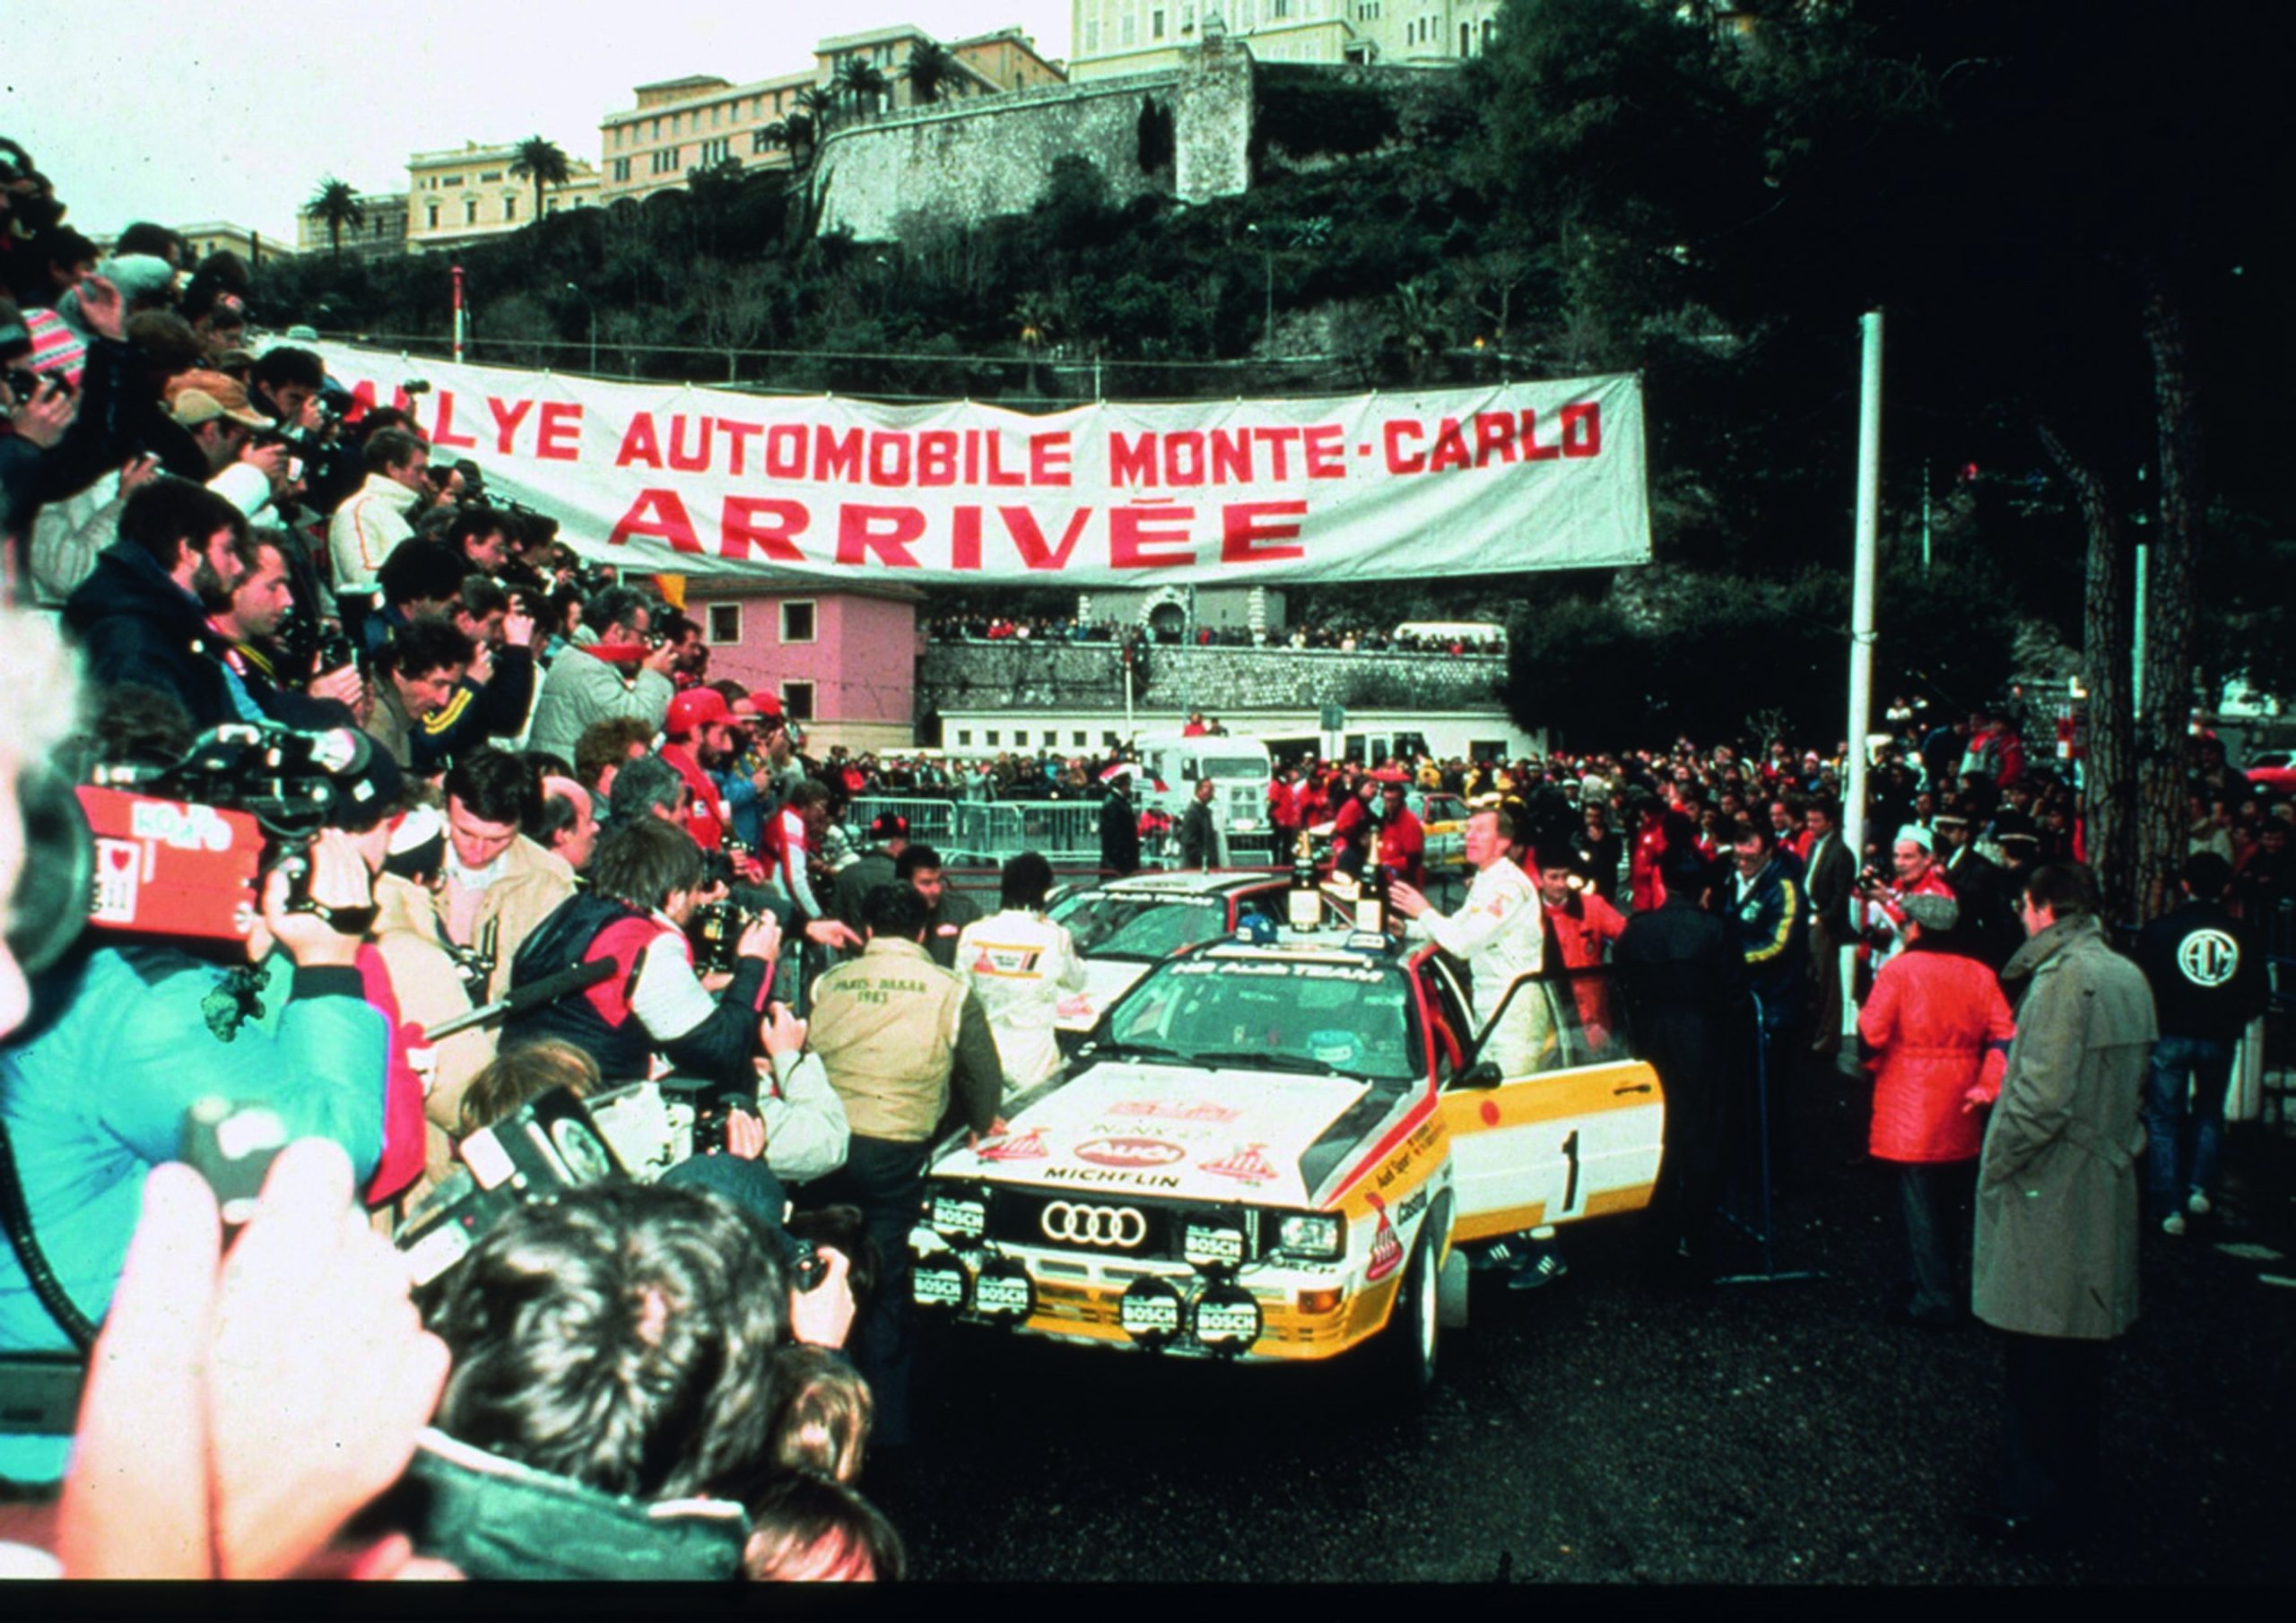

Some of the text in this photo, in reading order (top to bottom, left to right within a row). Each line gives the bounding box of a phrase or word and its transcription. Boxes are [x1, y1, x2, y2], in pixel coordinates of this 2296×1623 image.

[615, 412, 1073, 487] AUTOMOBILE
[1109, 402, 1602, 488] MONTE-CARLO
[607, 489, 1308, 570] ARRIVÉE
[1043, 1167, 1181, 1189] MICHELIN
[1561, 1129, 1579, 1213] 1
[934, 1207, 985, 1229] BOSCH
[1185, 1236, 1242, 1257] BOSCH
[913, 1277, 962, 1298] BOSCH
[978, 1285, 1028, 1306] BOSCH
[1122, 1306, 1178, 1326] BOSCH
[1197, 1313, 1257, 1332] BOSCH
